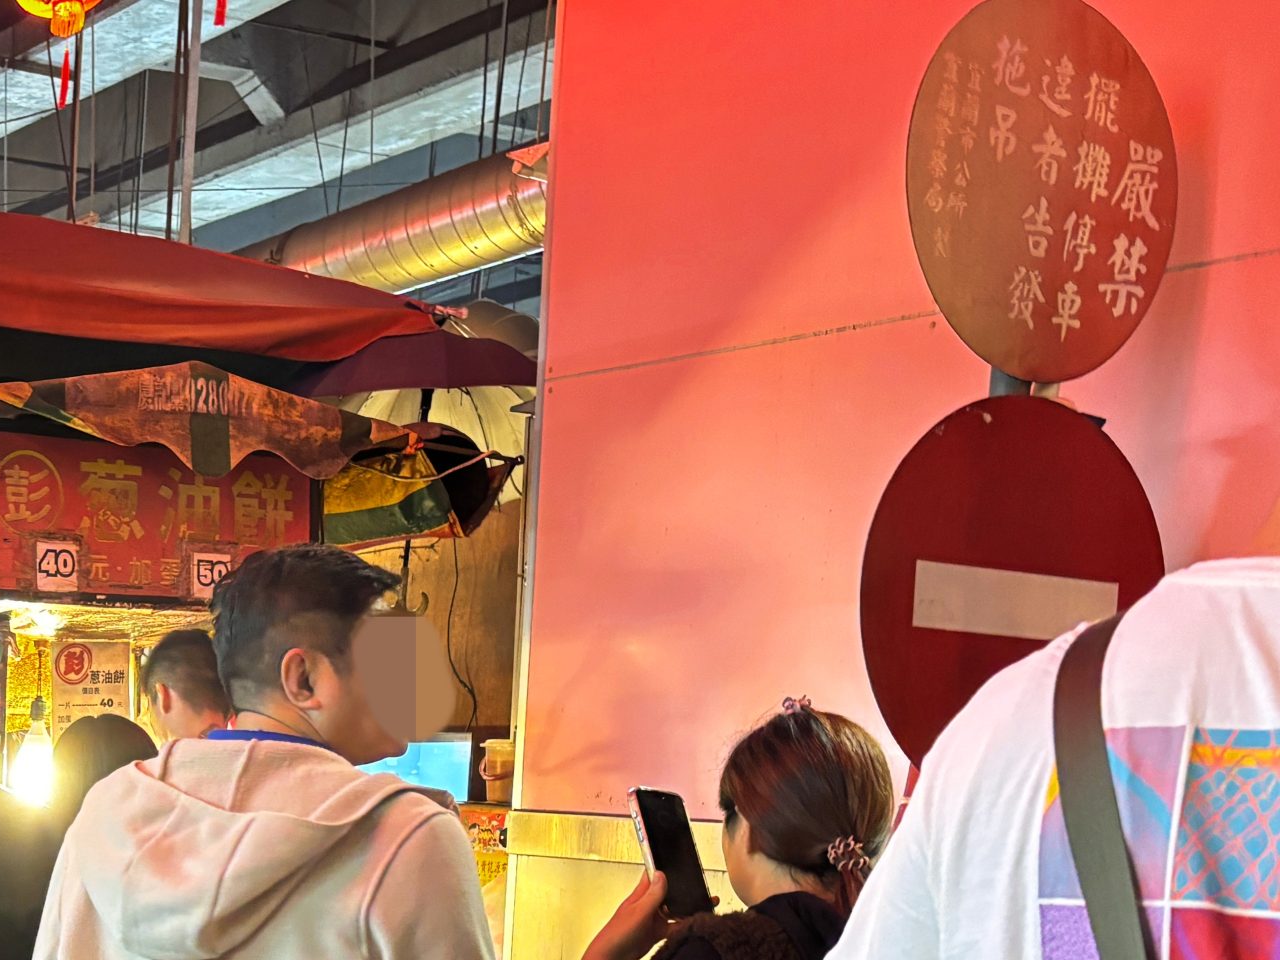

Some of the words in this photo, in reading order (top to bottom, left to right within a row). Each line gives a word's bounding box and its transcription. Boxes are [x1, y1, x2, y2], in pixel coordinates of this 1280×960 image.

[989, 35, 1031, 162] 拖吊
[1007, 55, 1076, 330] 違者告發
[1051, 72, 1121, 342] 擺攤停車
[1098, 139, 1163, 317] 嚴禁
[4, 465, 52, 523] 彭
[38, 549, 76, 578] 40
[197, 561, 231, 587] 50
[100, 698, 114, 708] 40
